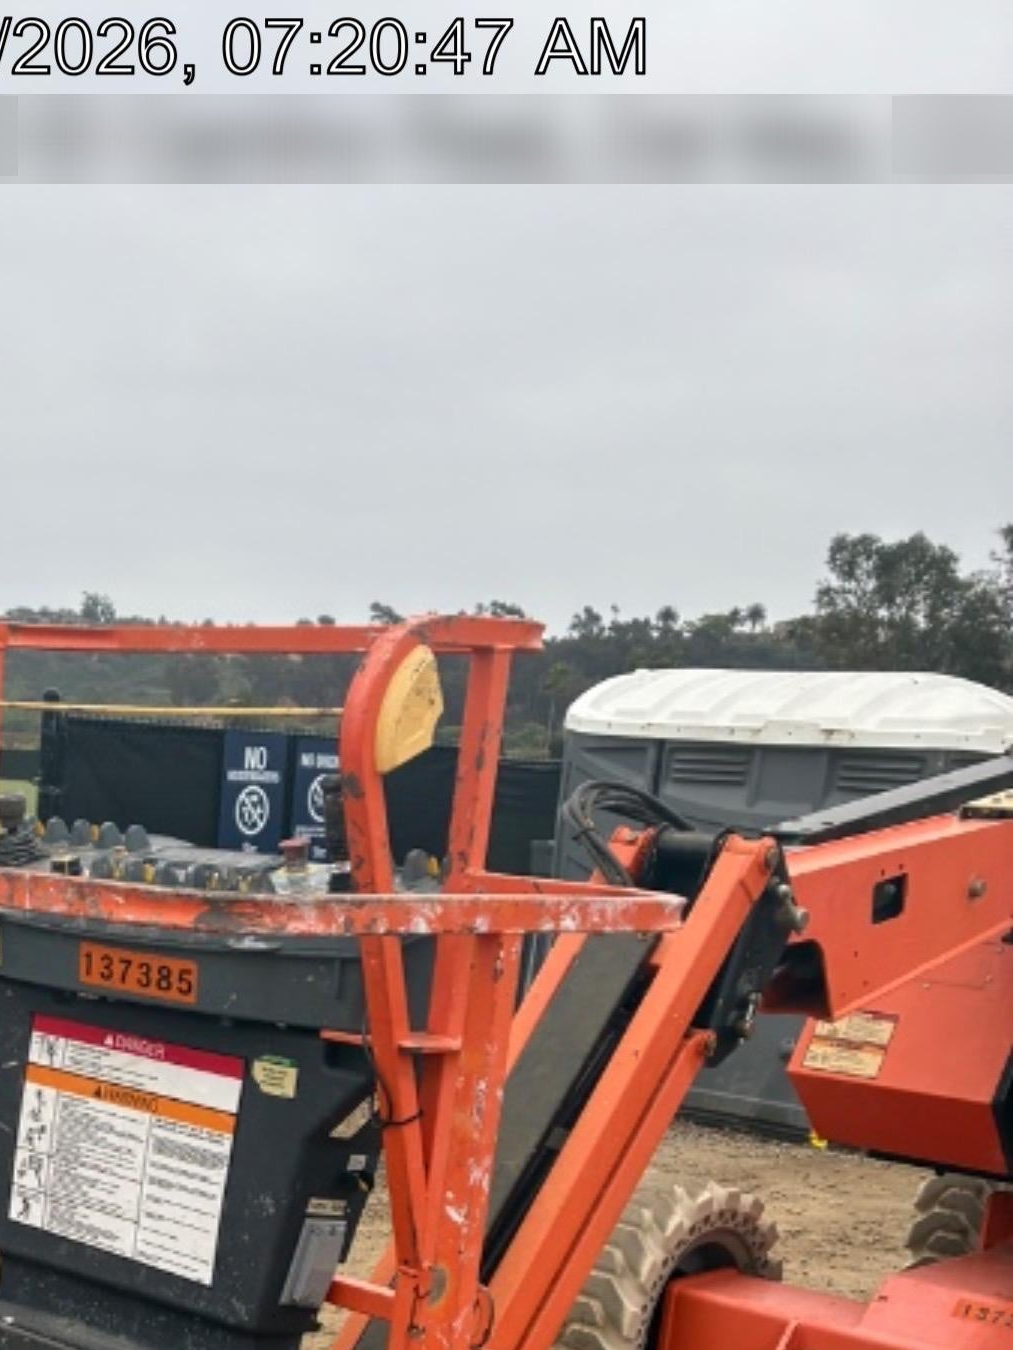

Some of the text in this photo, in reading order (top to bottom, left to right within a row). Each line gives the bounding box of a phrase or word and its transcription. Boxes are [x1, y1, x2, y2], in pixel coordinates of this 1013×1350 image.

[244, 746, 267, 770] NO
[84, 951, 193, 995] 137385
[114, 1033, 166, 1060] DANGER
